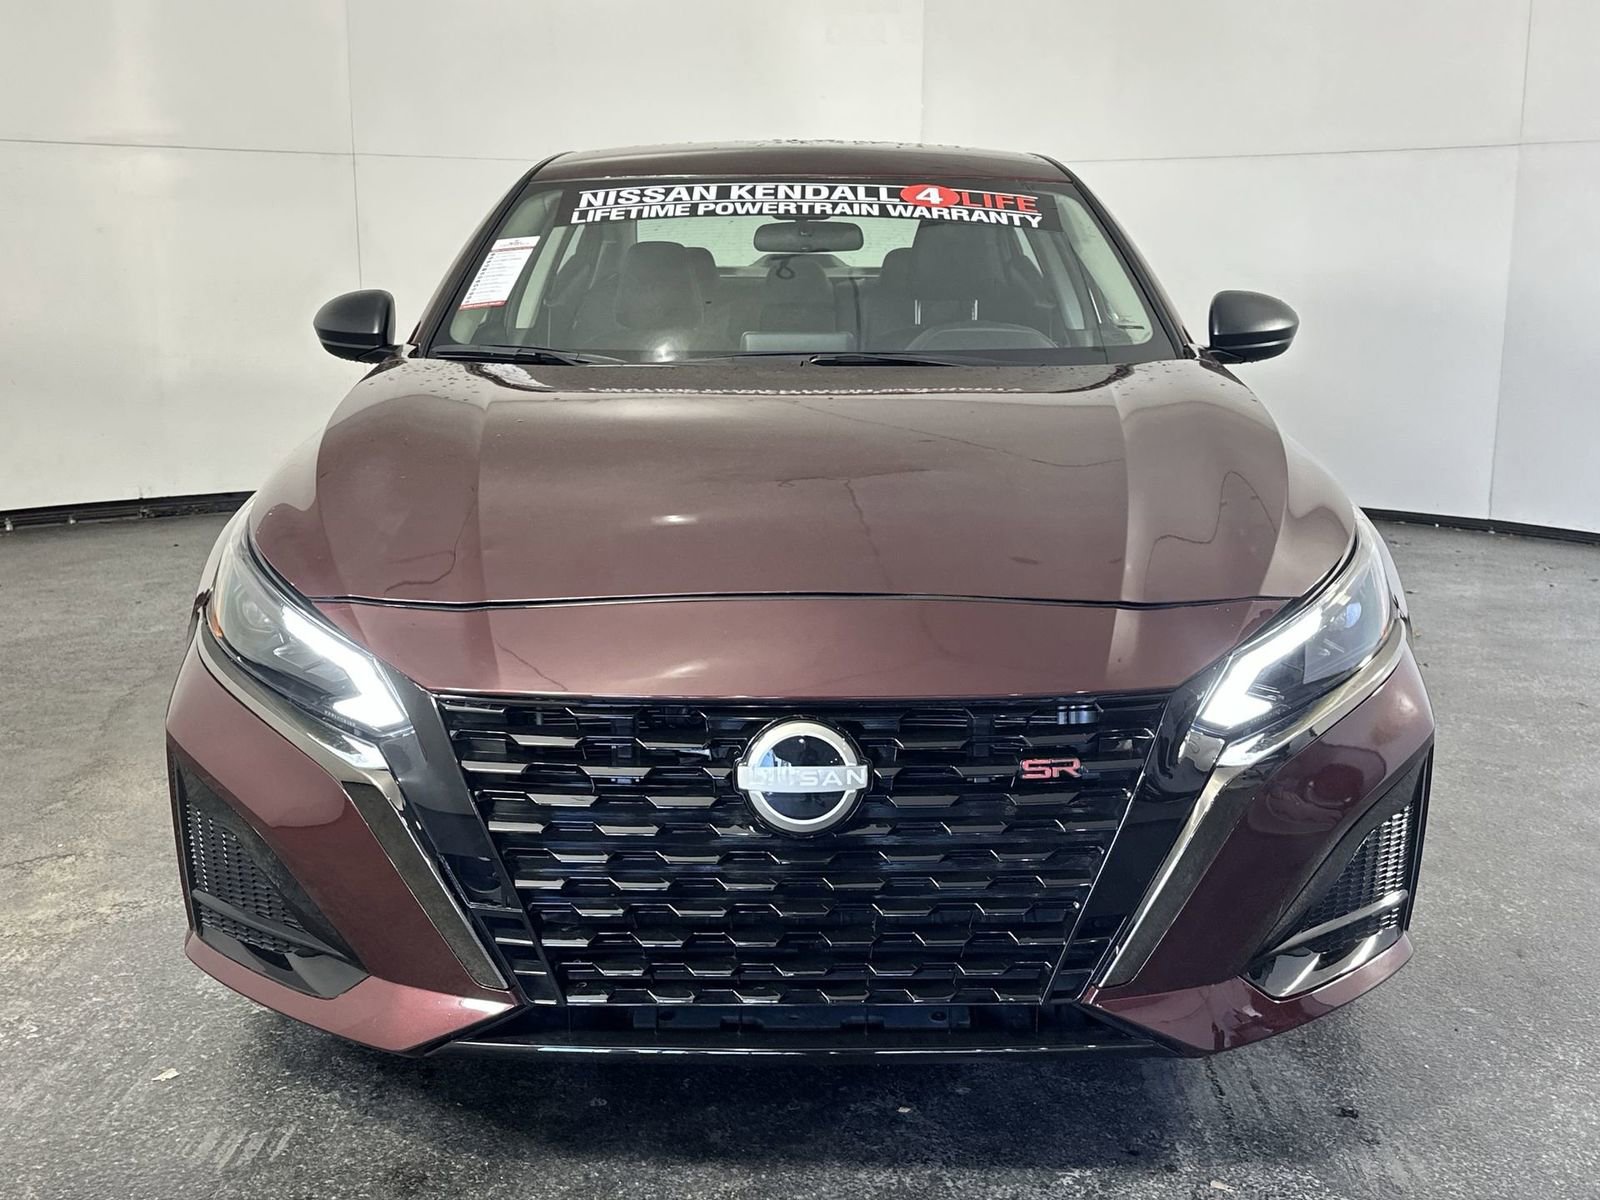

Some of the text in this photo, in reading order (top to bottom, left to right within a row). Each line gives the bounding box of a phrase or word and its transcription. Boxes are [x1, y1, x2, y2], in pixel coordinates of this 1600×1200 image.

[578, 184, 1038, 212] NISSAN KENDALL 4 LIFE
[570, 202, 1042, 228] LIFETIME POWERTRAIN WARRANTY
[743, 768, 866, 787] SAN
[1021, 758, 1082, 779] SR
